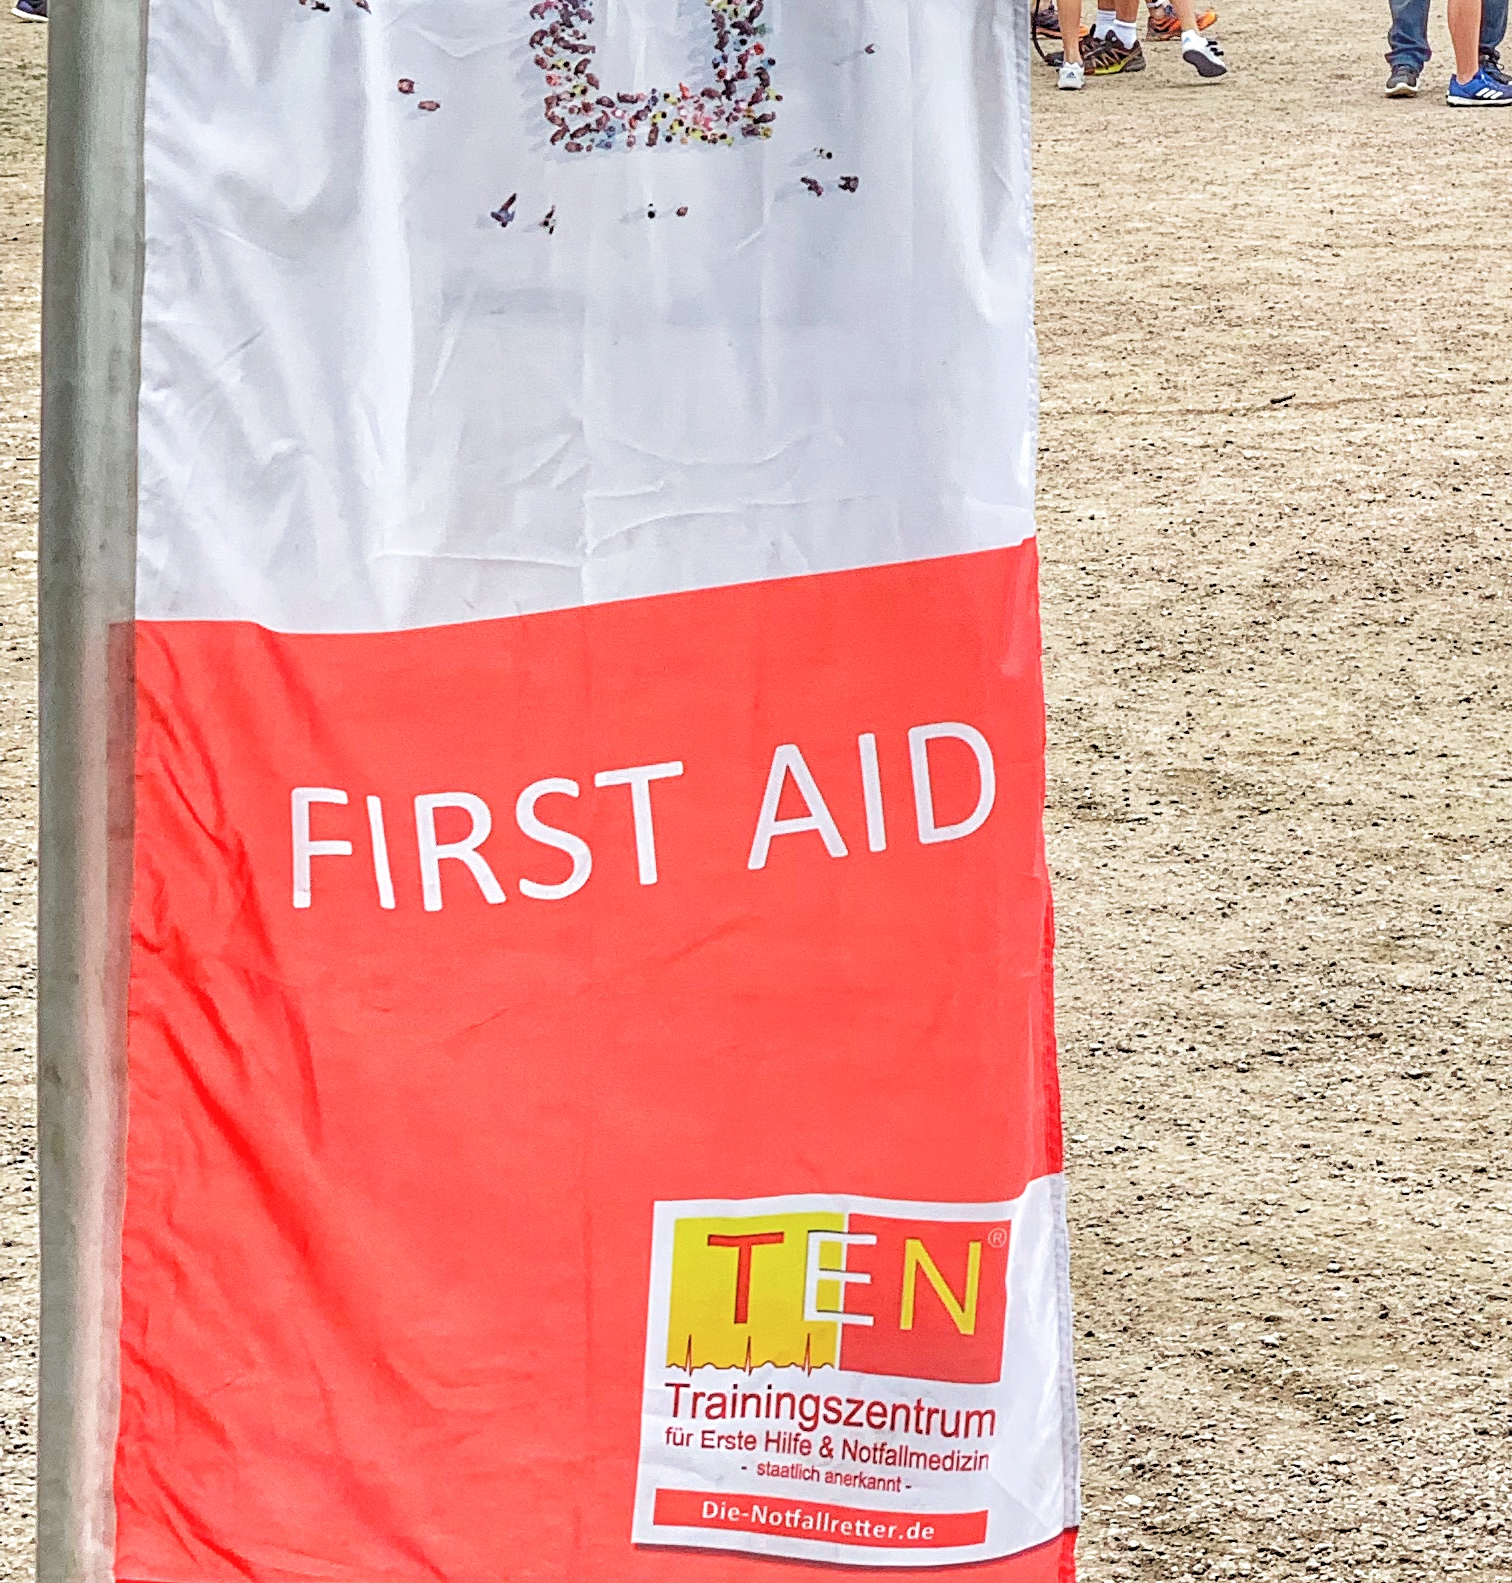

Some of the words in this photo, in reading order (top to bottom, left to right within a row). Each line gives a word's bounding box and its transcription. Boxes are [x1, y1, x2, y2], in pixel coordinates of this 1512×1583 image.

[291, 760, 684, 912] FIRST
[747, 721, 997, 870] AID
[707, 1229, 982, 1336] TEN
[664, 1382, 996, 1440] Trainingszentrum
[665, 1426, 694, 1448] für
[700, 1430, 757, 1452] Erste
[765, 1431, 812, 1456] Hilfe
[818, 1438, 834, 1458] &
[842, 1439, 989, 1472] Notfallmedizin
[756, 1461, 821, 1483] staatlich
[824, 1468, 902, 1493] anerkannt
[701, 1499, 935, 1541] Die-Notfallretter.de
